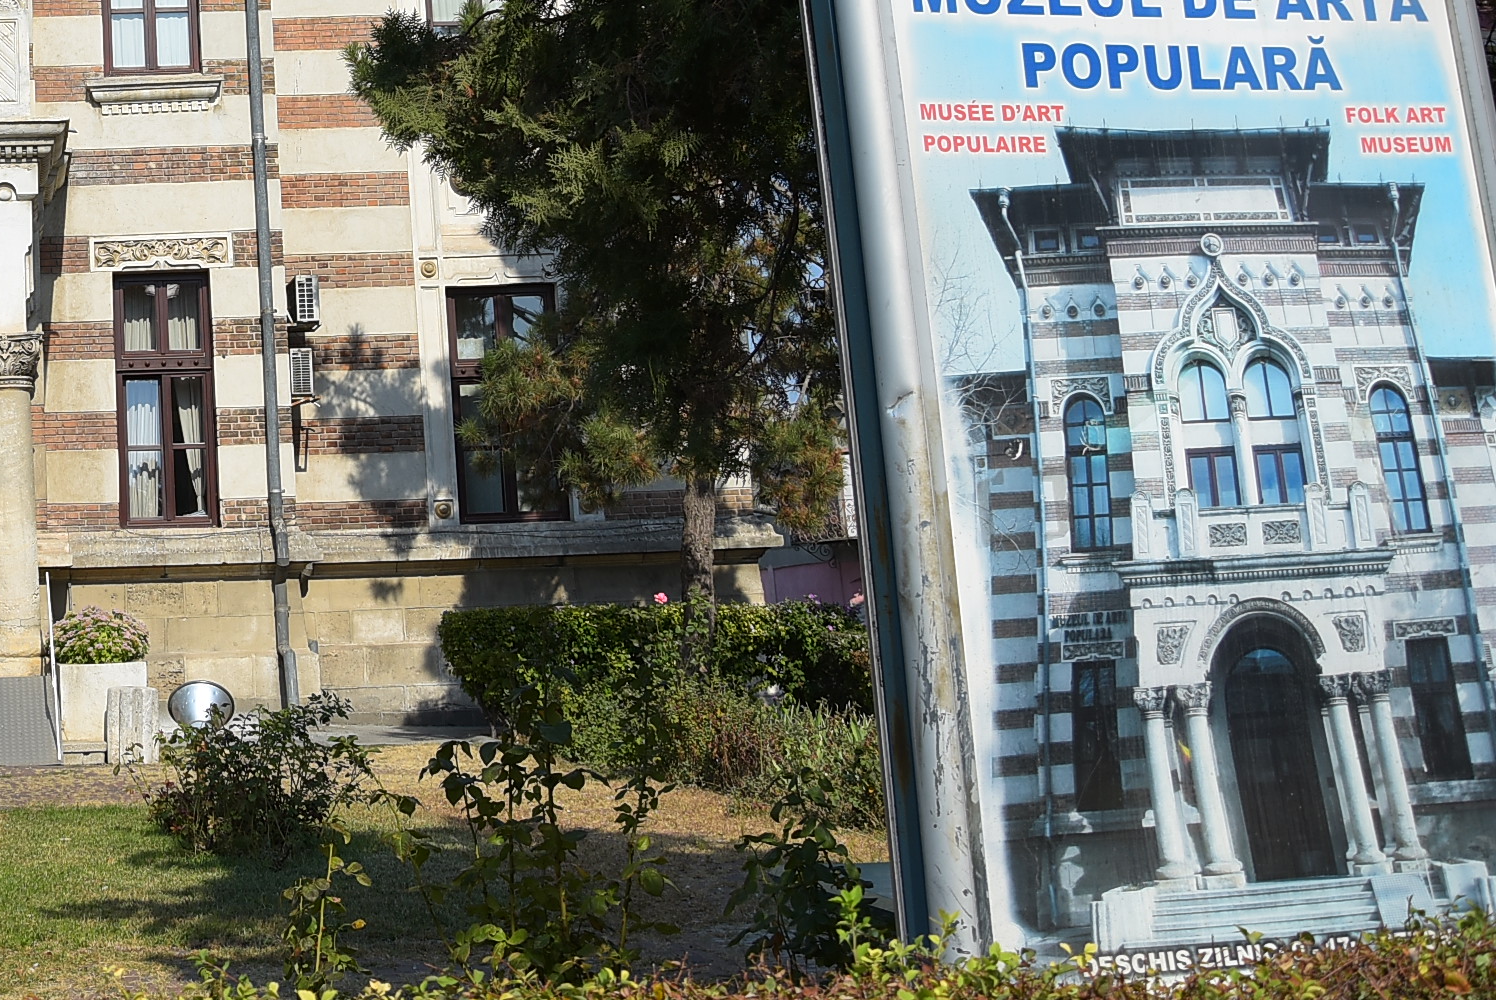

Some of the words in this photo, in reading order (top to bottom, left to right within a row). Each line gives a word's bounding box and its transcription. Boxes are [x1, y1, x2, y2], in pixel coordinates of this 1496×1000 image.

[1021, 35, 1344, 91] POPULARĂ
[919, 99, 995, 122] MUSÉE
[1345, 106, 1401, 124] FOLK
[1406, 106, 1446, 124] ART
[922, 134, 1047, 153] POPULAIRE
[1360, 136, 1453, 154] MUSEUM
